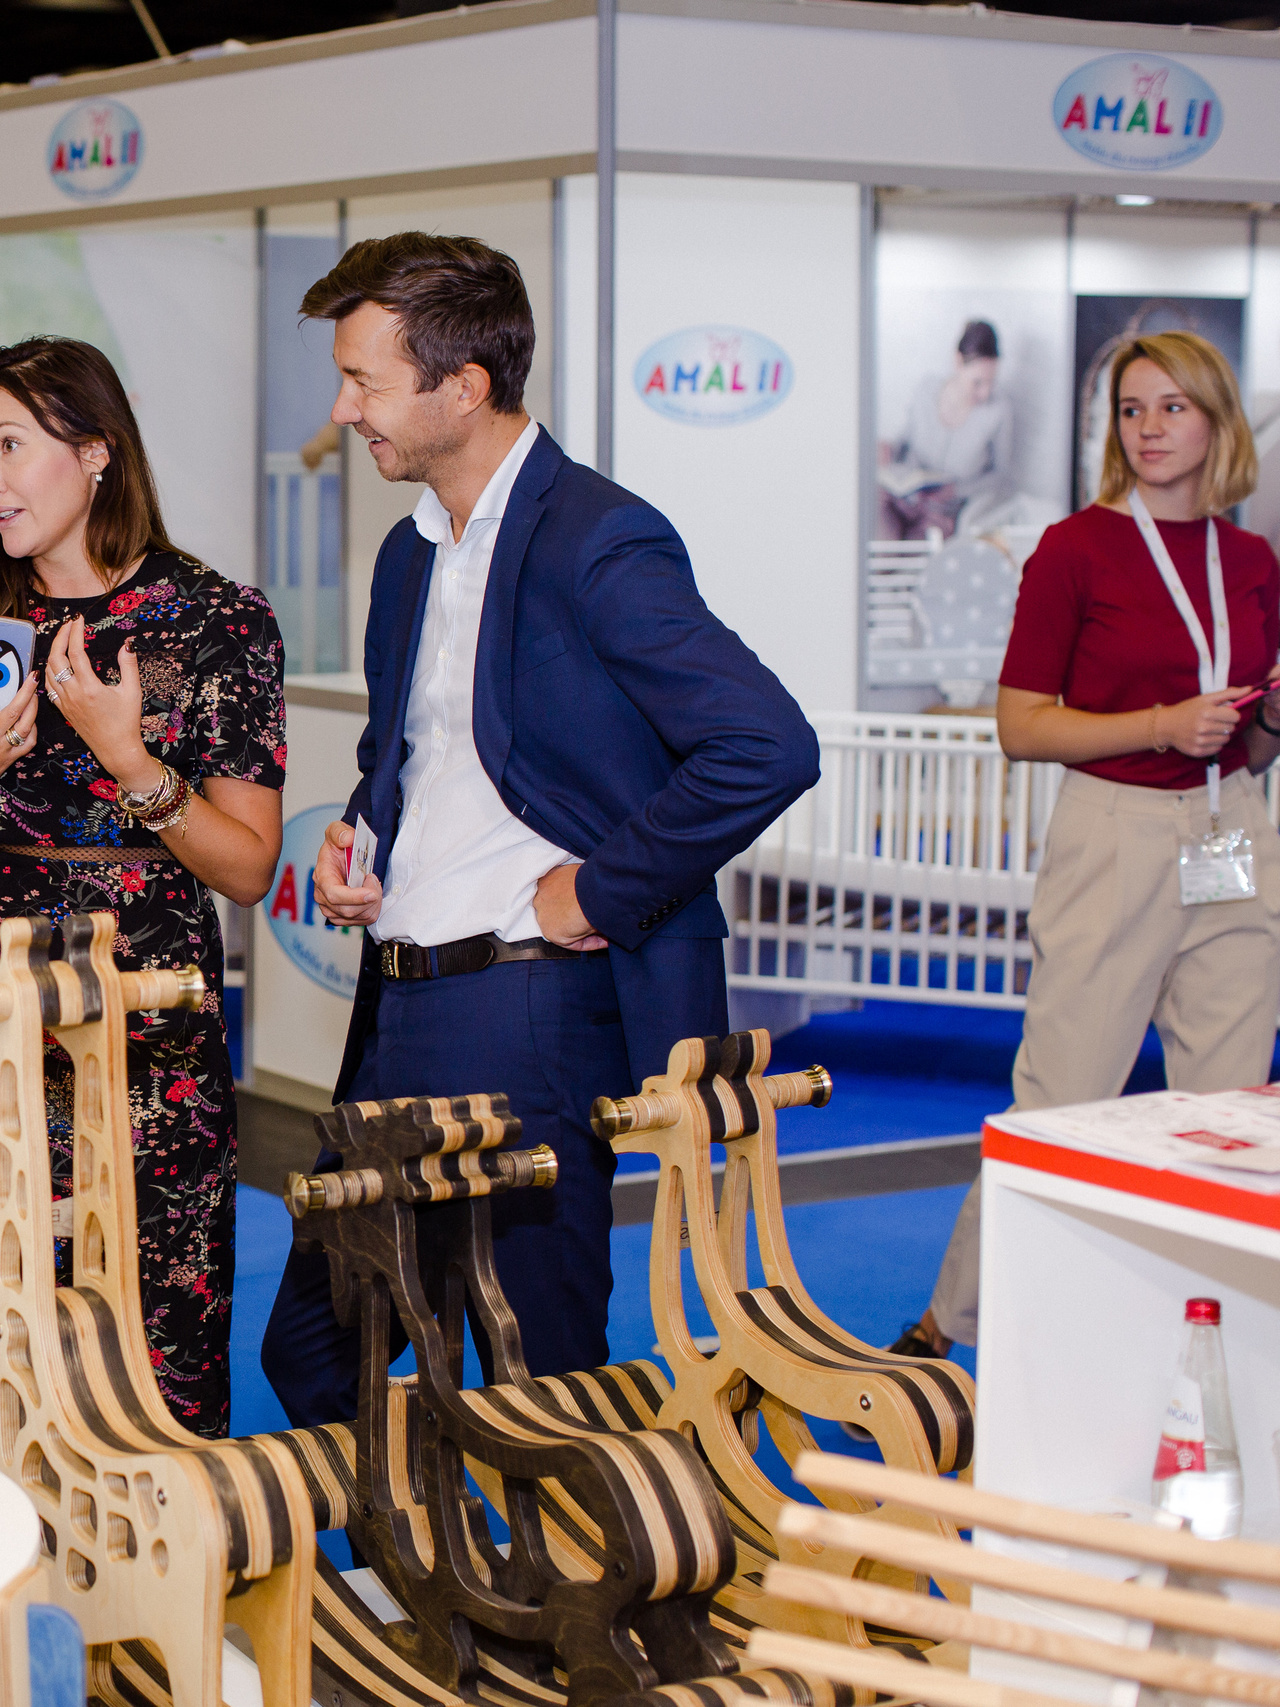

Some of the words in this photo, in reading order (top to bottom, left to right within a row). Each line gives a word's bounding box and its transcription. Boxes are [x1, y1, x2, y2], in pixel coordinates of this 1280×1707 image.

[1062, 94, 1172, 135] AMAL
[50, 132, 116, 174] AMAL
[644, 363, 745, 394] AMAL
